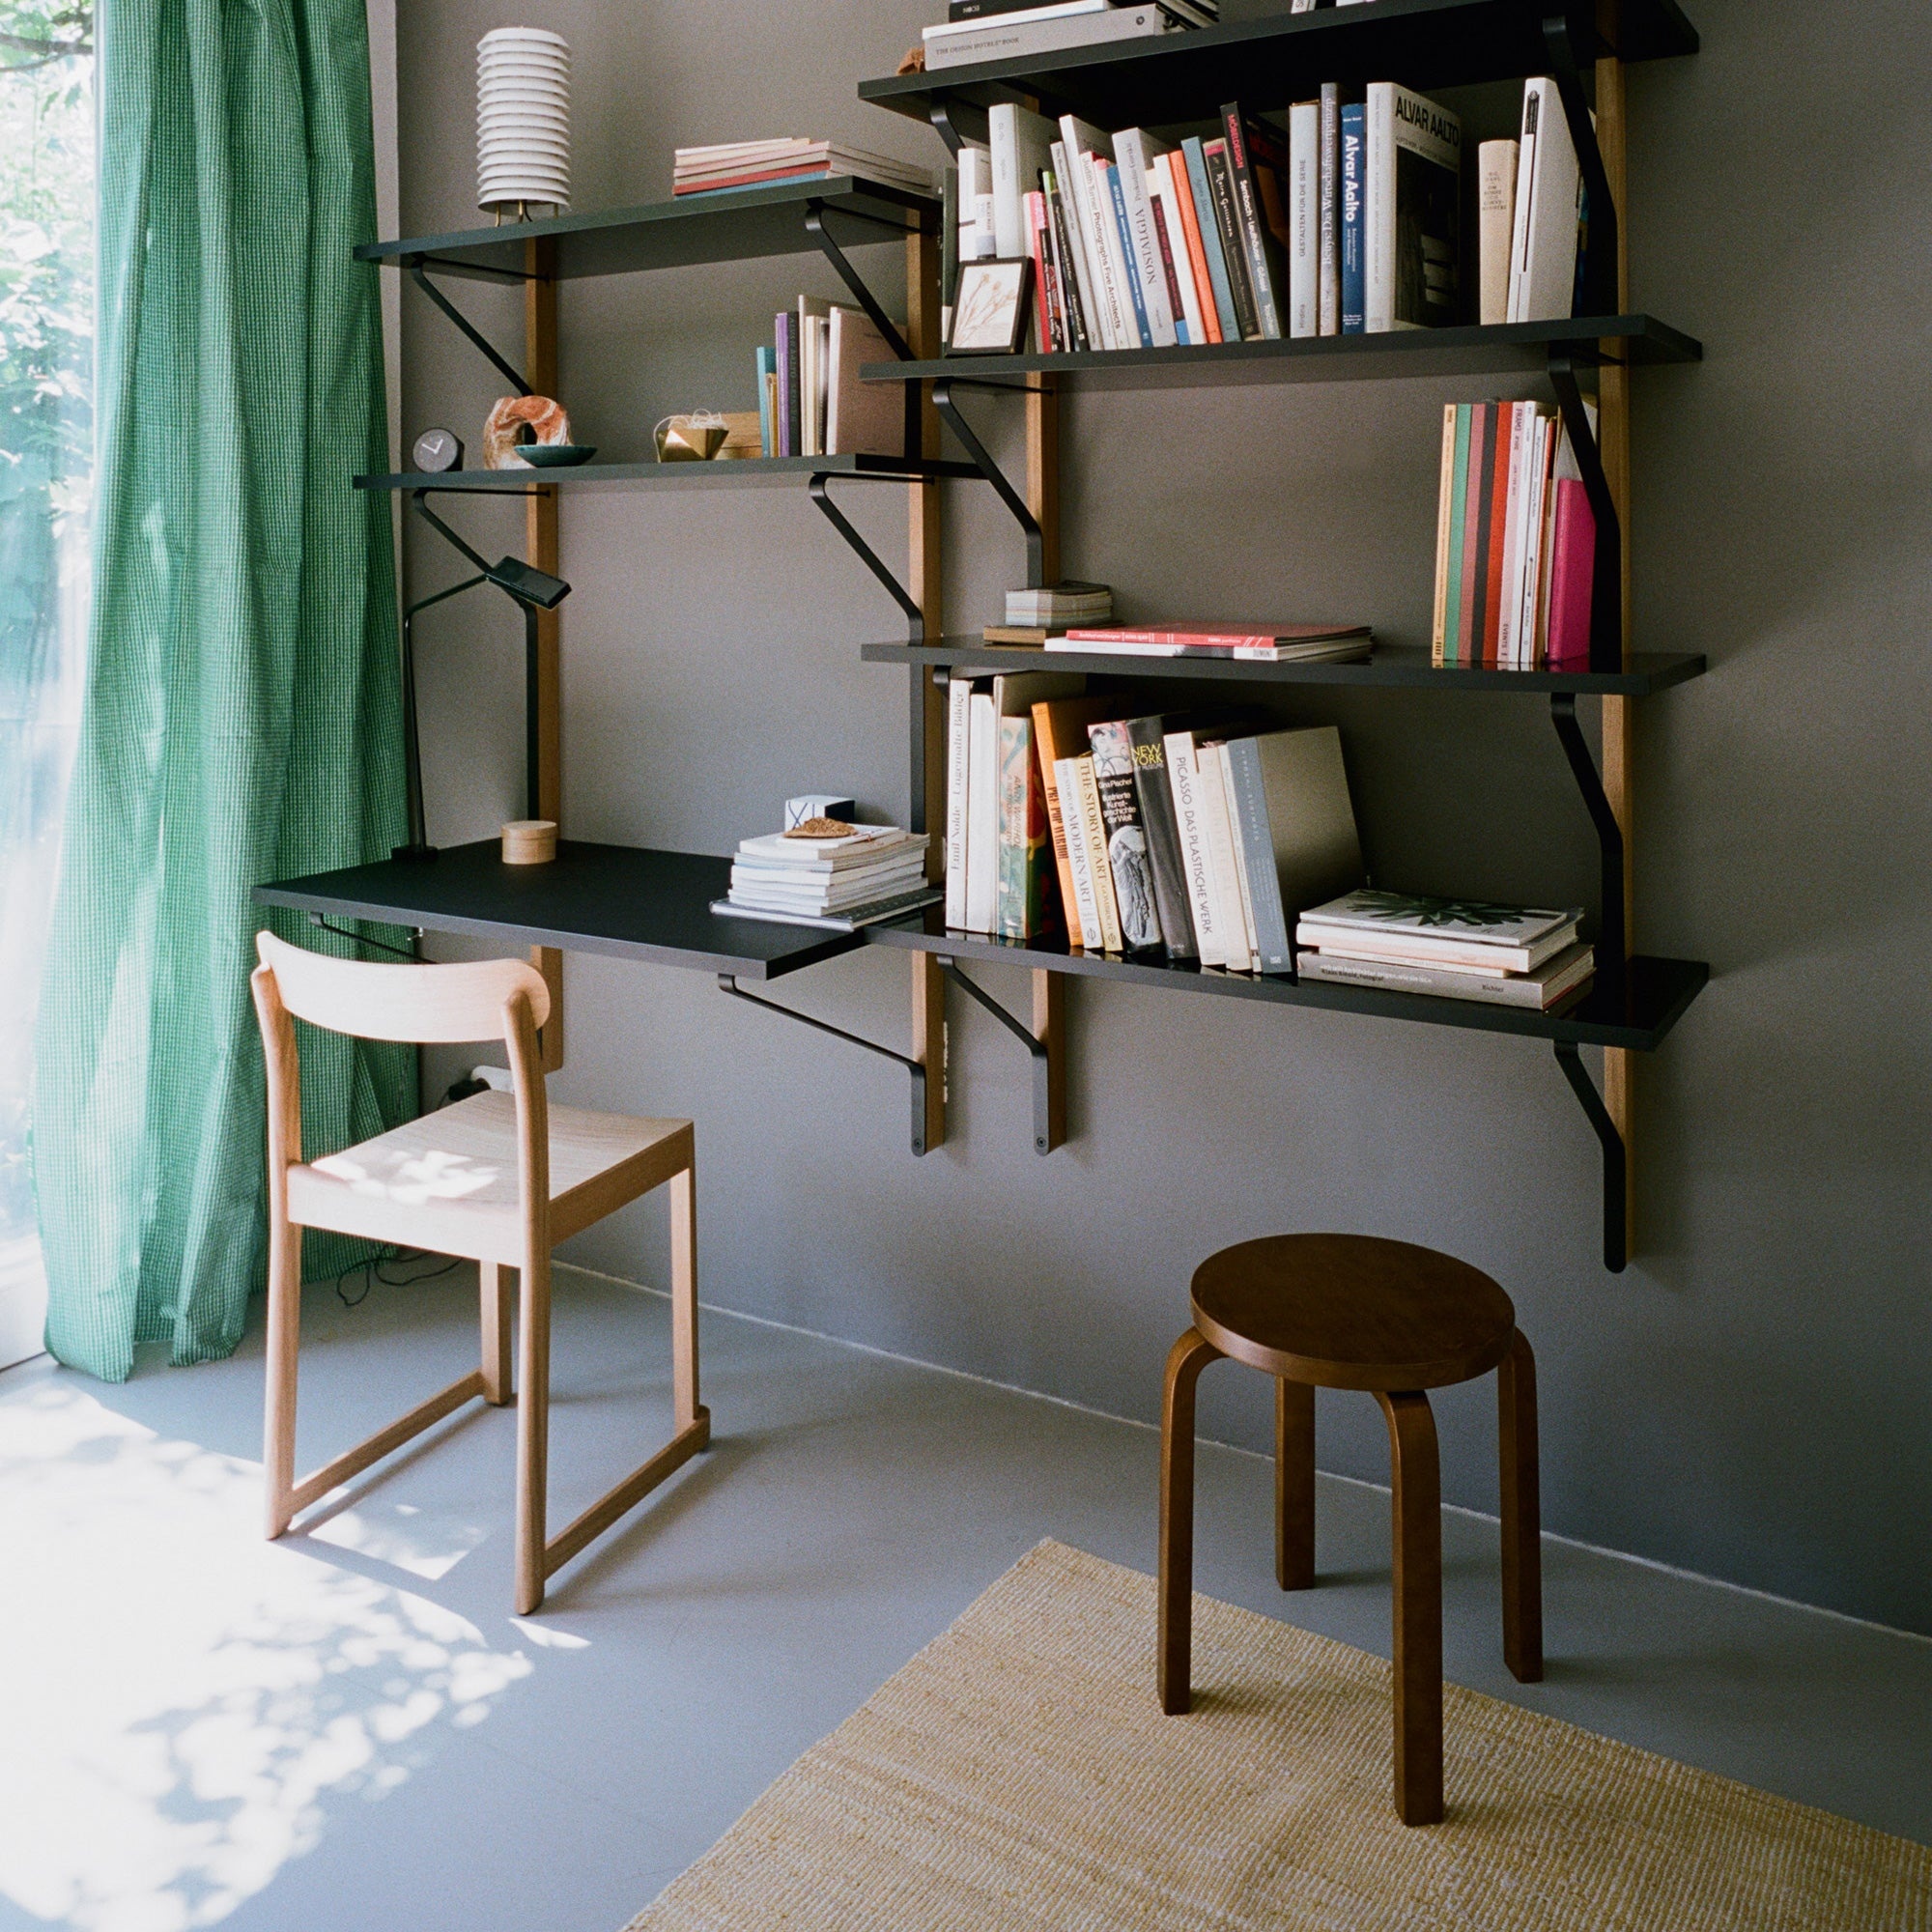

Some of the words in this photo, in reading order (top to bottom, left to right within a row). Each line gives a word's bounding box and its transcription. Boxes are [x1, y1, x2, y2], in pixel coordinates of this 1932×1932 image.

[1395, 96, 1430, 131] ALVAR
[1431, 112, 1460, 147] AALTO
[1081, 157, 1094, 185] Judith
[1346, 135, 1359, 178] Alvar
[1087, 185, 1099, 211] Turner
[1345, 180, 1359, 222] Aalto
[1322, 212, 1333, 230] Das
[1090, 212, 1111, 267] Photographs
[1134, 209, 1156, 284] NOSTALGIA
[1103, 267, 1114, 285] Five
[1106, 286, 1123, 329] Architects
[1130, 743, 1161, 756] NEW
[1131, 753, 1163, 766] YORK
[1080, 763, 1093, 789] THE
[1176, 756, 1193, 806] PICASSO
[952, 806, 961, 838] Nolde
[1085, 792, 1099, 834] STORY
[1184, 810, 1197, 833] DAS
[951, 842, 960, 869] Emil
[1067, 814, 1088, 875] MODERN
[1078, 877, 1092, 907] ART
[1092, 836, 1102, 853] OF
[1094, 856, 1107, 882] ART
[1187, 835, 1208, 899] PLASTISCHE
[1198, 901, 1213, 935] WERK
